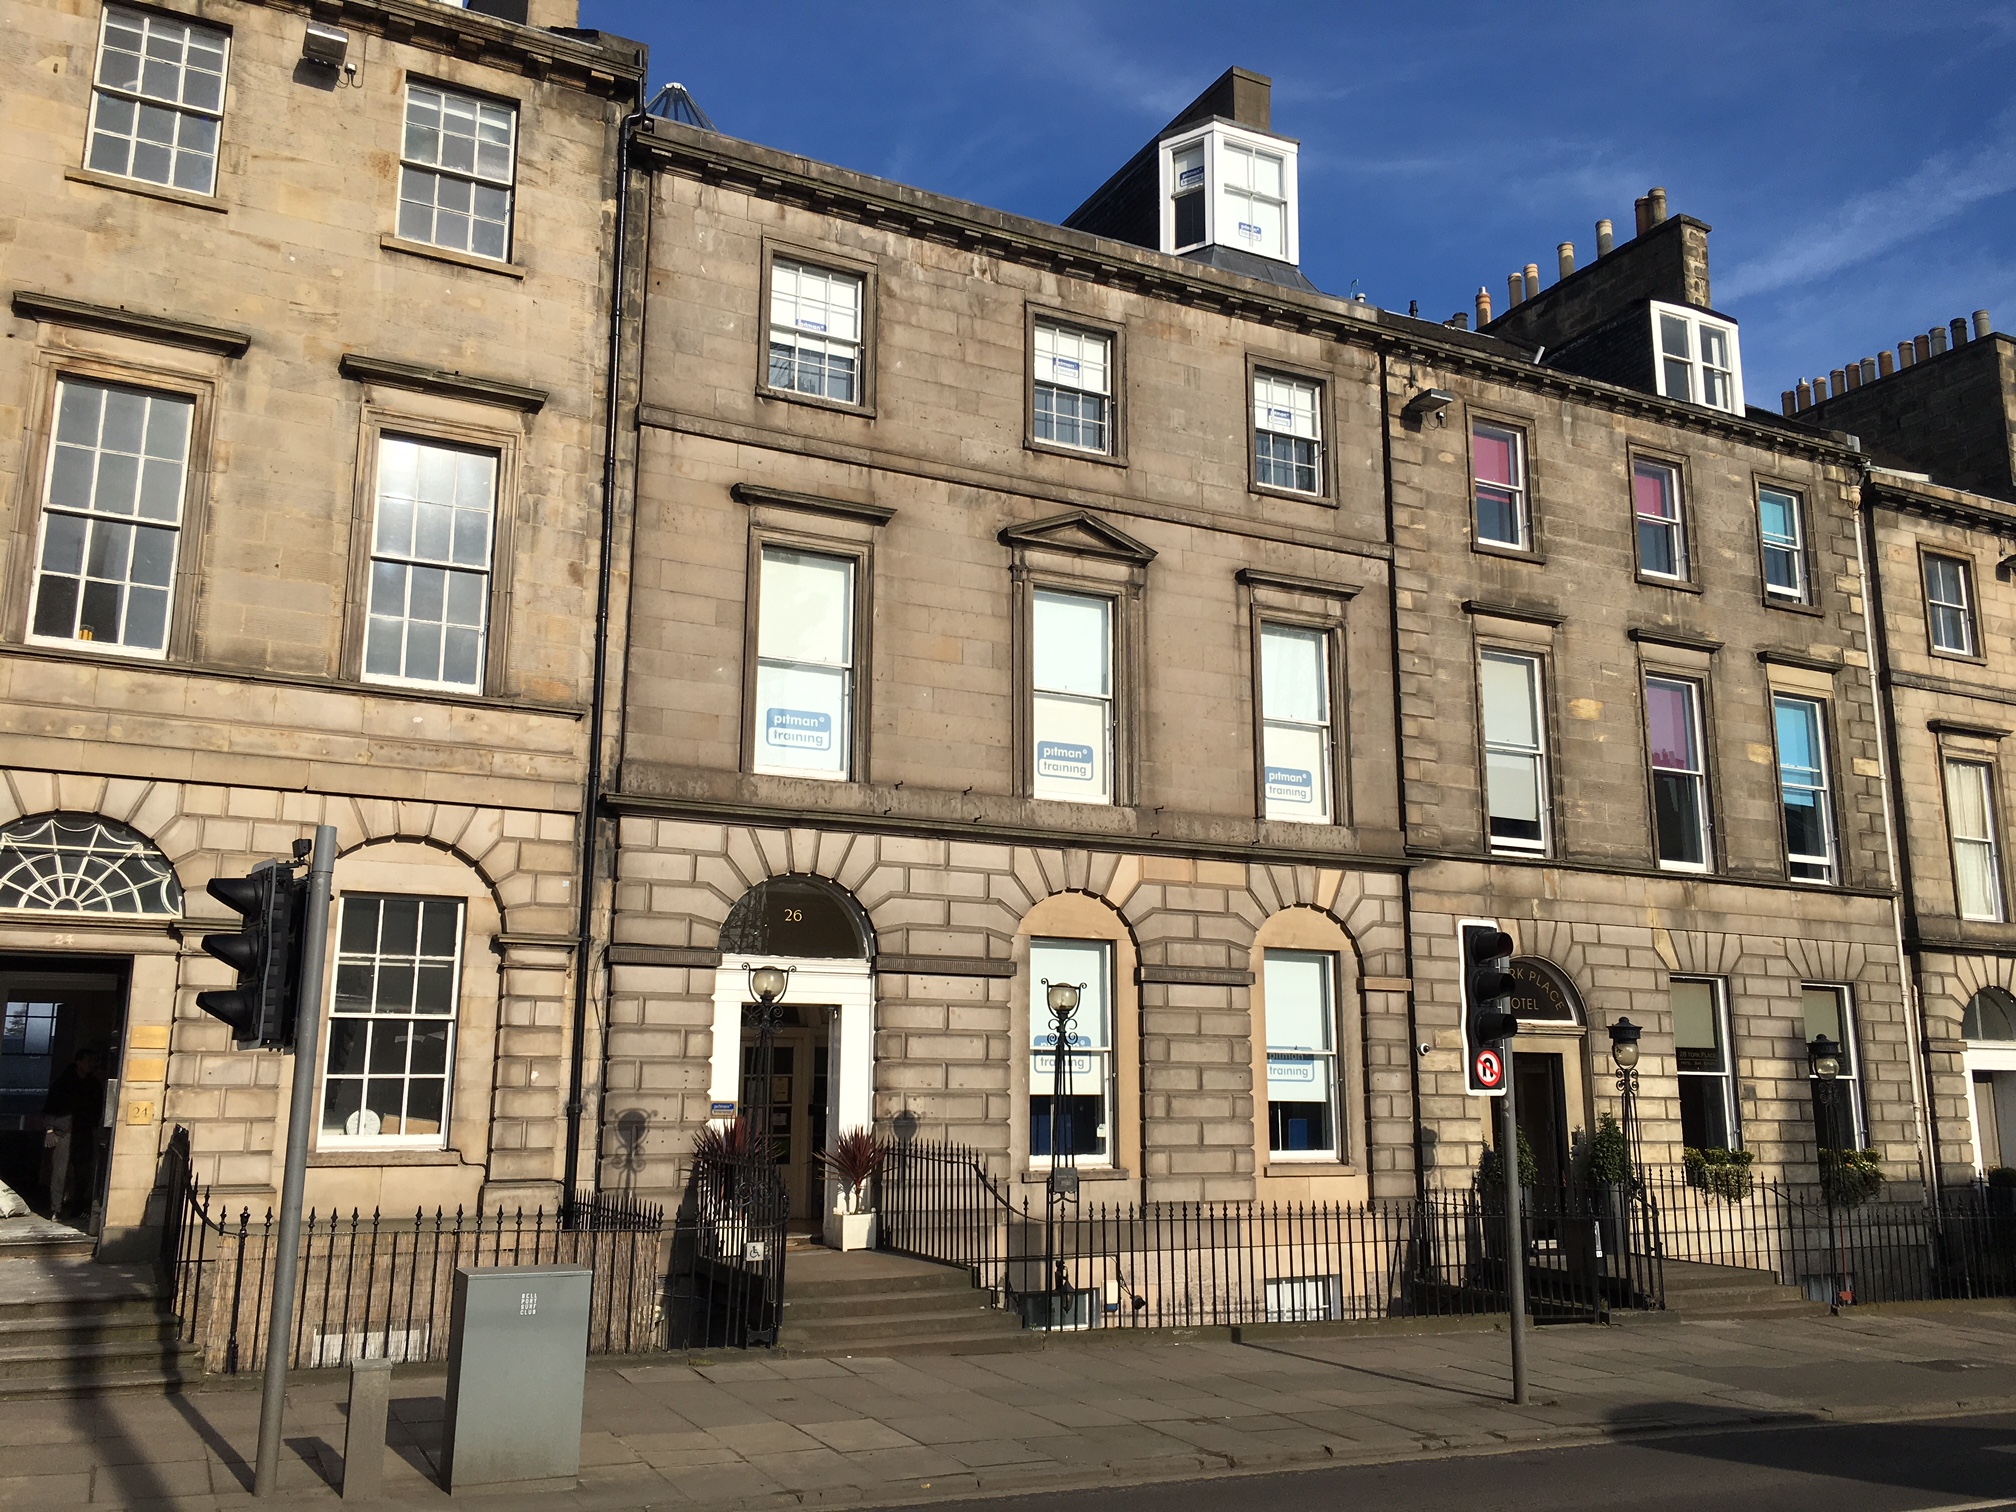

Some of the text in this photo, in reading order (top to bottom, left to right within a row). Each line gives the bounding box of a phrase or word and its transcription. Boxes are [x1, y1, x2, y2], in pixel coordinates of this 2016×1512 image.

[773, 713, 819, 728] pitman
[773, 729, 824, 747] training
[1043, 746, 1082, 759] pitman
[1043, 760, 1087, 777] training
[1268, 771, 1303, 783] pitman
[1268, 784, 1308, 800] training
[784, 908, 803, 922] 26
[54, 933, 75, 946] 24
[1528, 970, 1566, 1012] PLACE
[1510, 997, 1540, 1011] OTEL
[1268, 1065, 1309, 1079] training
[132, 1106, 149, 1119] 24
